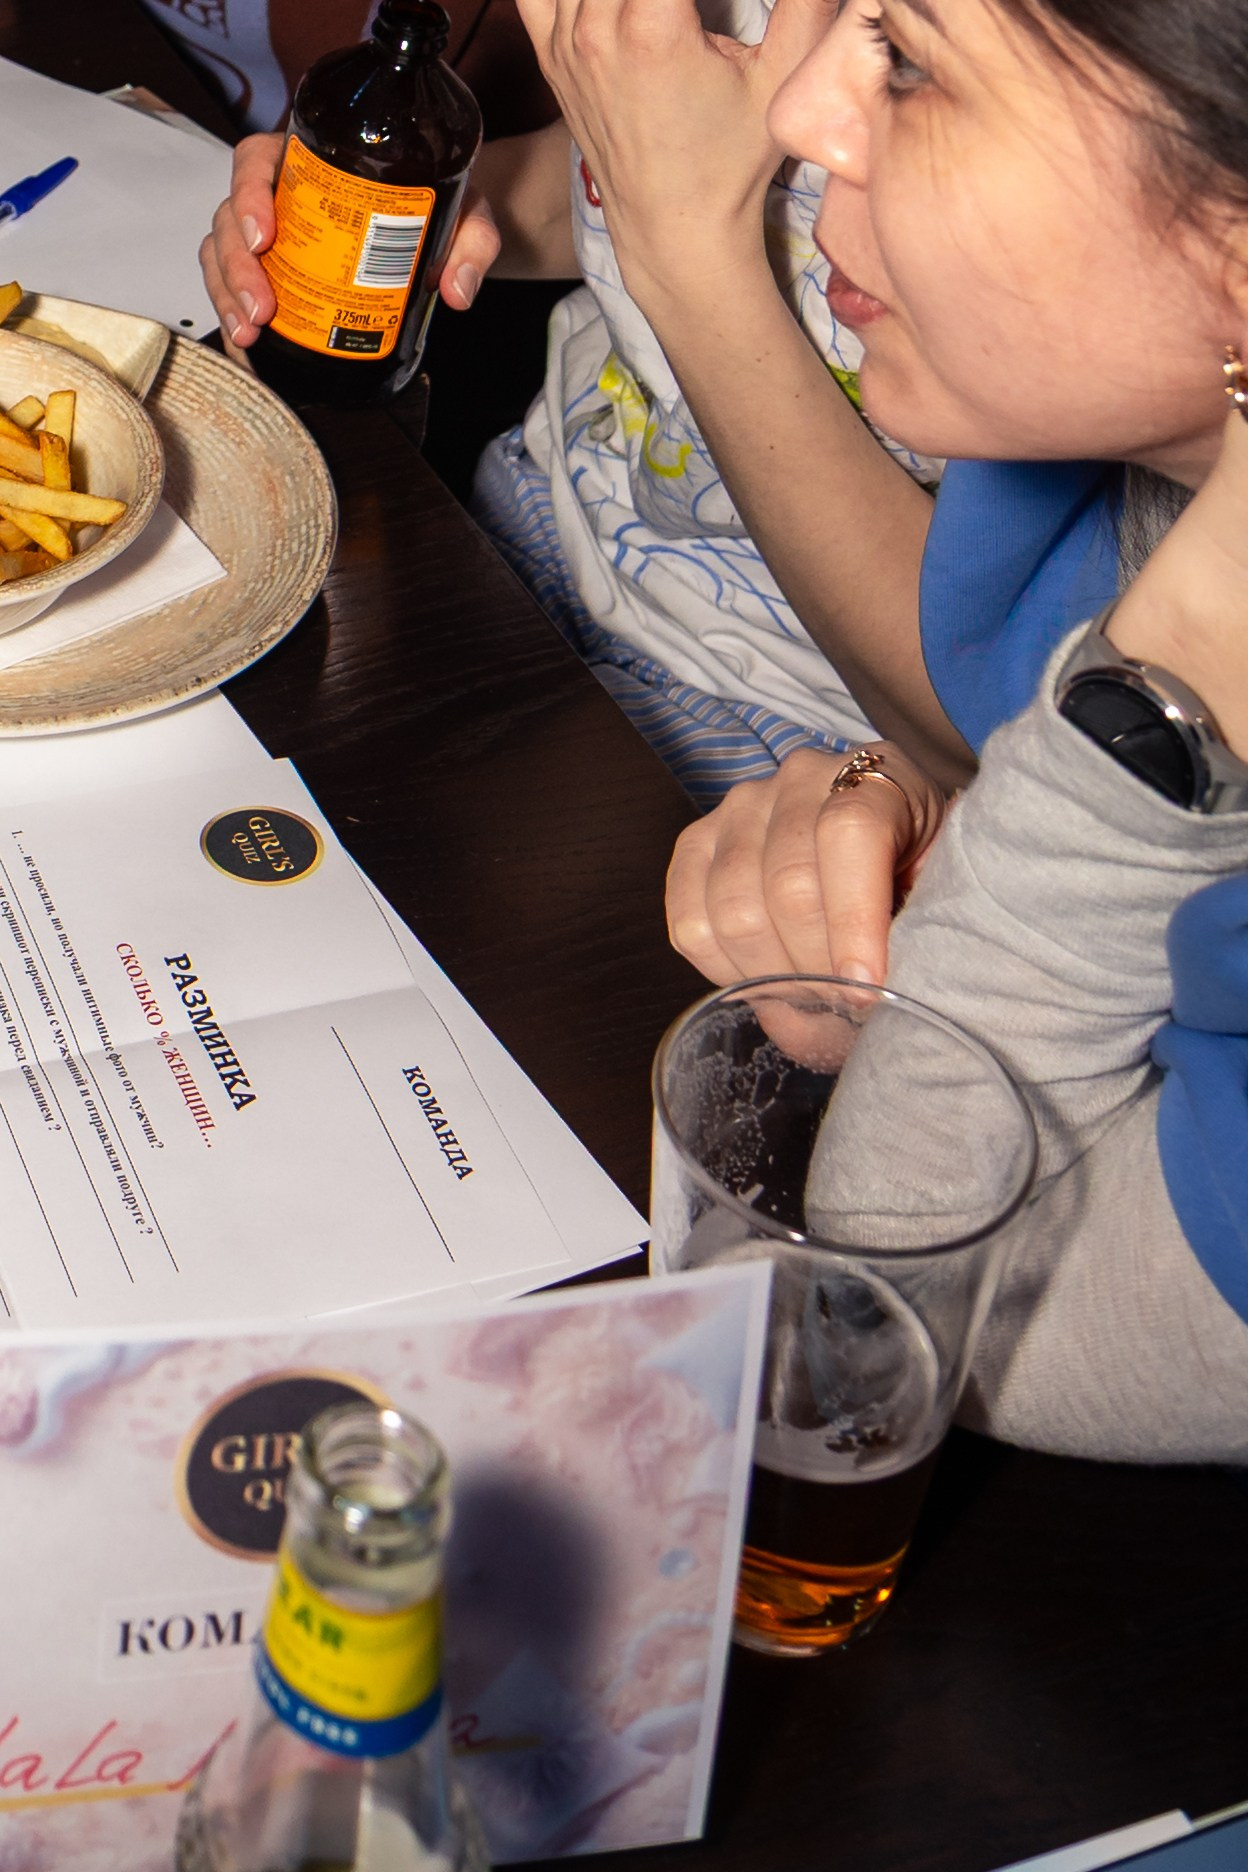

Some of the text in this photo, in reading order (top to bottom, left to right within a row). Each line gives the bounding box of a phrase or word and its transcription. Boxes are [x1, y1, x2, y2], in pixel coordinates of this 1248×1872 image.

[11, 830, 23, 839] 1.
[23, 855, 36, 867] не
[232, 831, 260, 863] QUIZ
[248, 814, 294, 873] GIRL'S
[28, 869, 56, 916] просили,
[0, 900, 30, 954] скриншот
[50, 917, 64, 931] но
[23, 956, 56, 1017] переписки
[57, 933, 88, 986] получали
[81, 988, 114, 1052] интимные
[115, 942, 216, 1148] СКОЛЬКО % ЖЕНЩИН...
[163, 952, 257, 1111] РАЗМИНКА
[5, 1025, 27, 1062] перед
[20, 1064, 54, 1122] свиданием
[52, 1028, 89, 1087] мужчиной
[105, 1052, 128, 1078] фото
[79, 1088, 91, 1097] и
[122, 1079, 136, 1092] от
[84, 1099, 123, 1172] отправляли
[129, 1094, 164, 1149] мужчин?
[401, 1065, 476, 1180] КОМАНДА
[116, 1174, 146, 1225] подруге
